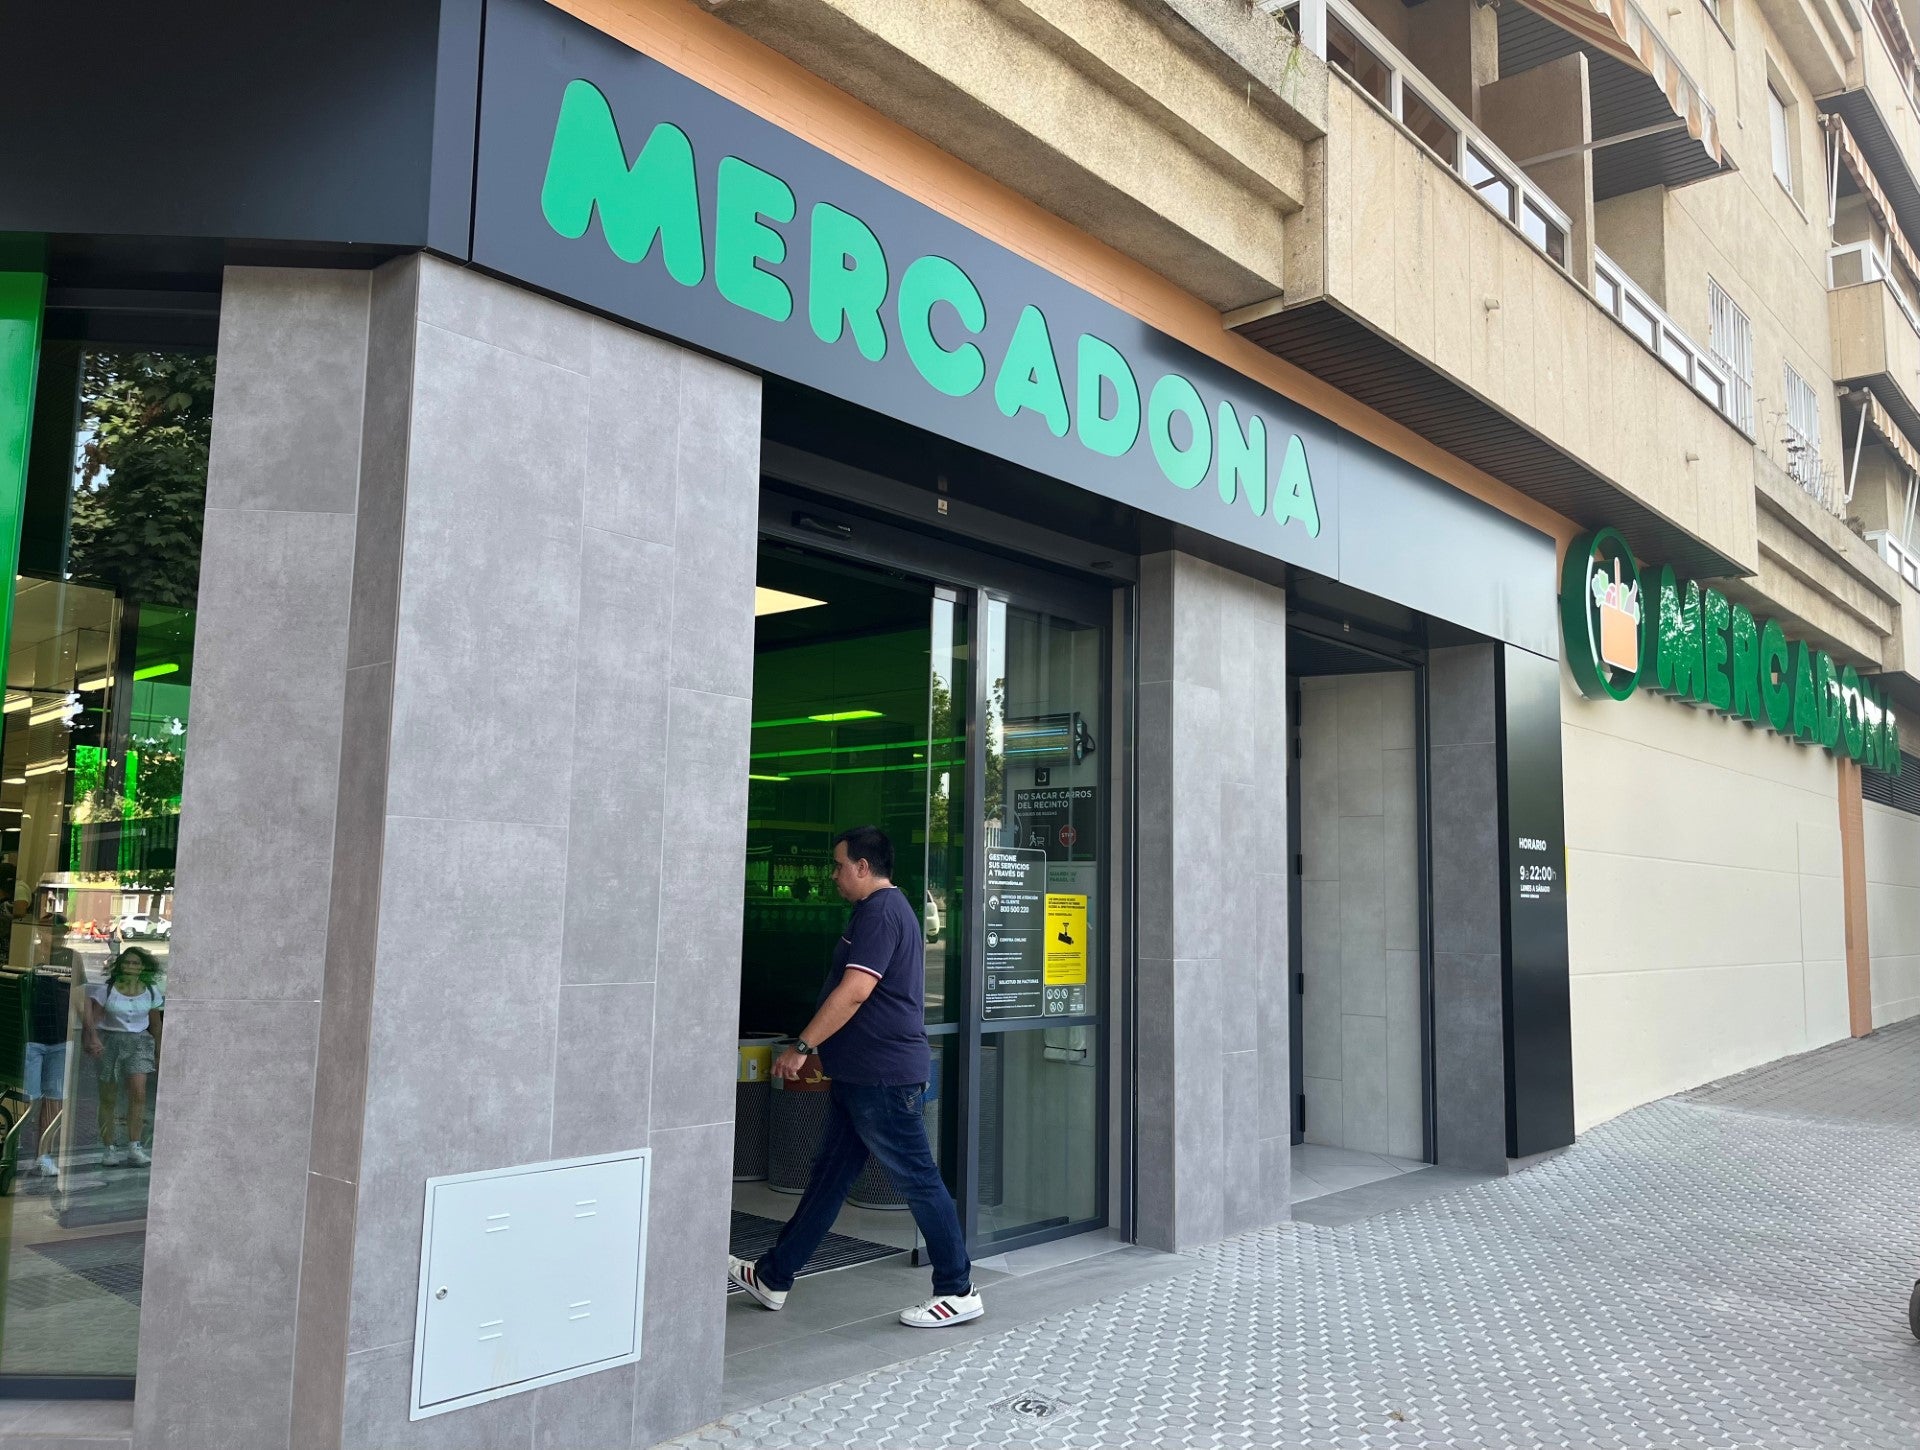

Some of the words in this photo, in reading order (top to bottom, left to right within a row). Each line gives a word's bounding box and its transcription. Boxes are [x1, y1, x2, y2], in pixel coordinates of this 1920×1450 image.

[541, 78, 1321, 538] MERCADONA
[1656, 563, 1902, 777] MERCADONA
[1031, 792, 1058, 800] SACAR
[1059, 790, 1092, 799] CARROS
[1034, 801, 1069, 809] RECINTO
[1519, 838, 1547, 851] HORARIO
[988, 854, 1017, 862] GESTIONE
[994, 869, 1016, 878] TRAVÉS
[1016, 870, 1025, 878] DE
[1520, 866, 1525, 880] 9
[1530, 866, 1552, 881] 22:00
